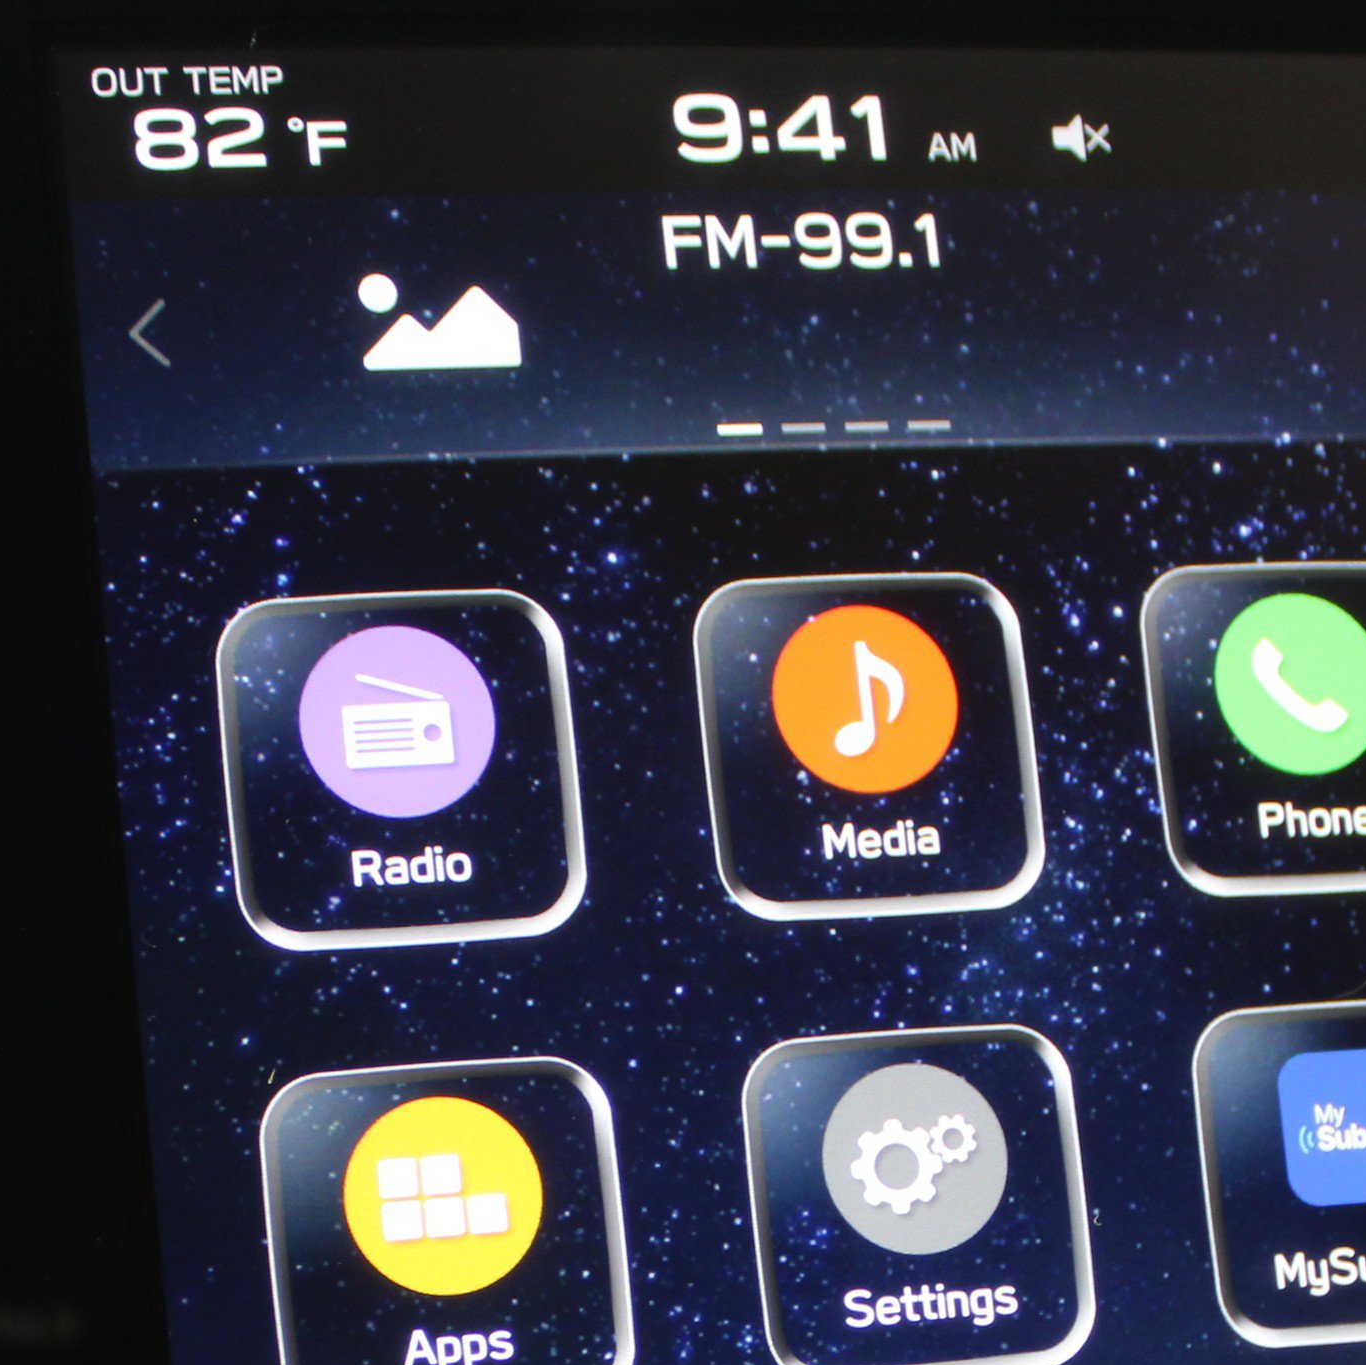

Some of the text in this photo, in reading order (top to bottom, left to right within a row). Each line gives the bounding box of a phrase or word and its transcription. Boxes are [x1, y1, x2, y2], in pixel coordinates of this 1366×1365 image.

[91, 64, 285, 97] OUT TEMP
[134, 108, 266, 170] 82
[673, 94, 976, 162] 9:41 AM
[662, 213, 939, 269] FM-99.1
[822, 820, 940, 859] Media
[352, 846, 472, 887] Radio
[1314, 1104, 1345, 1128] My
[844, 1283, 1018, 1327] Settings
